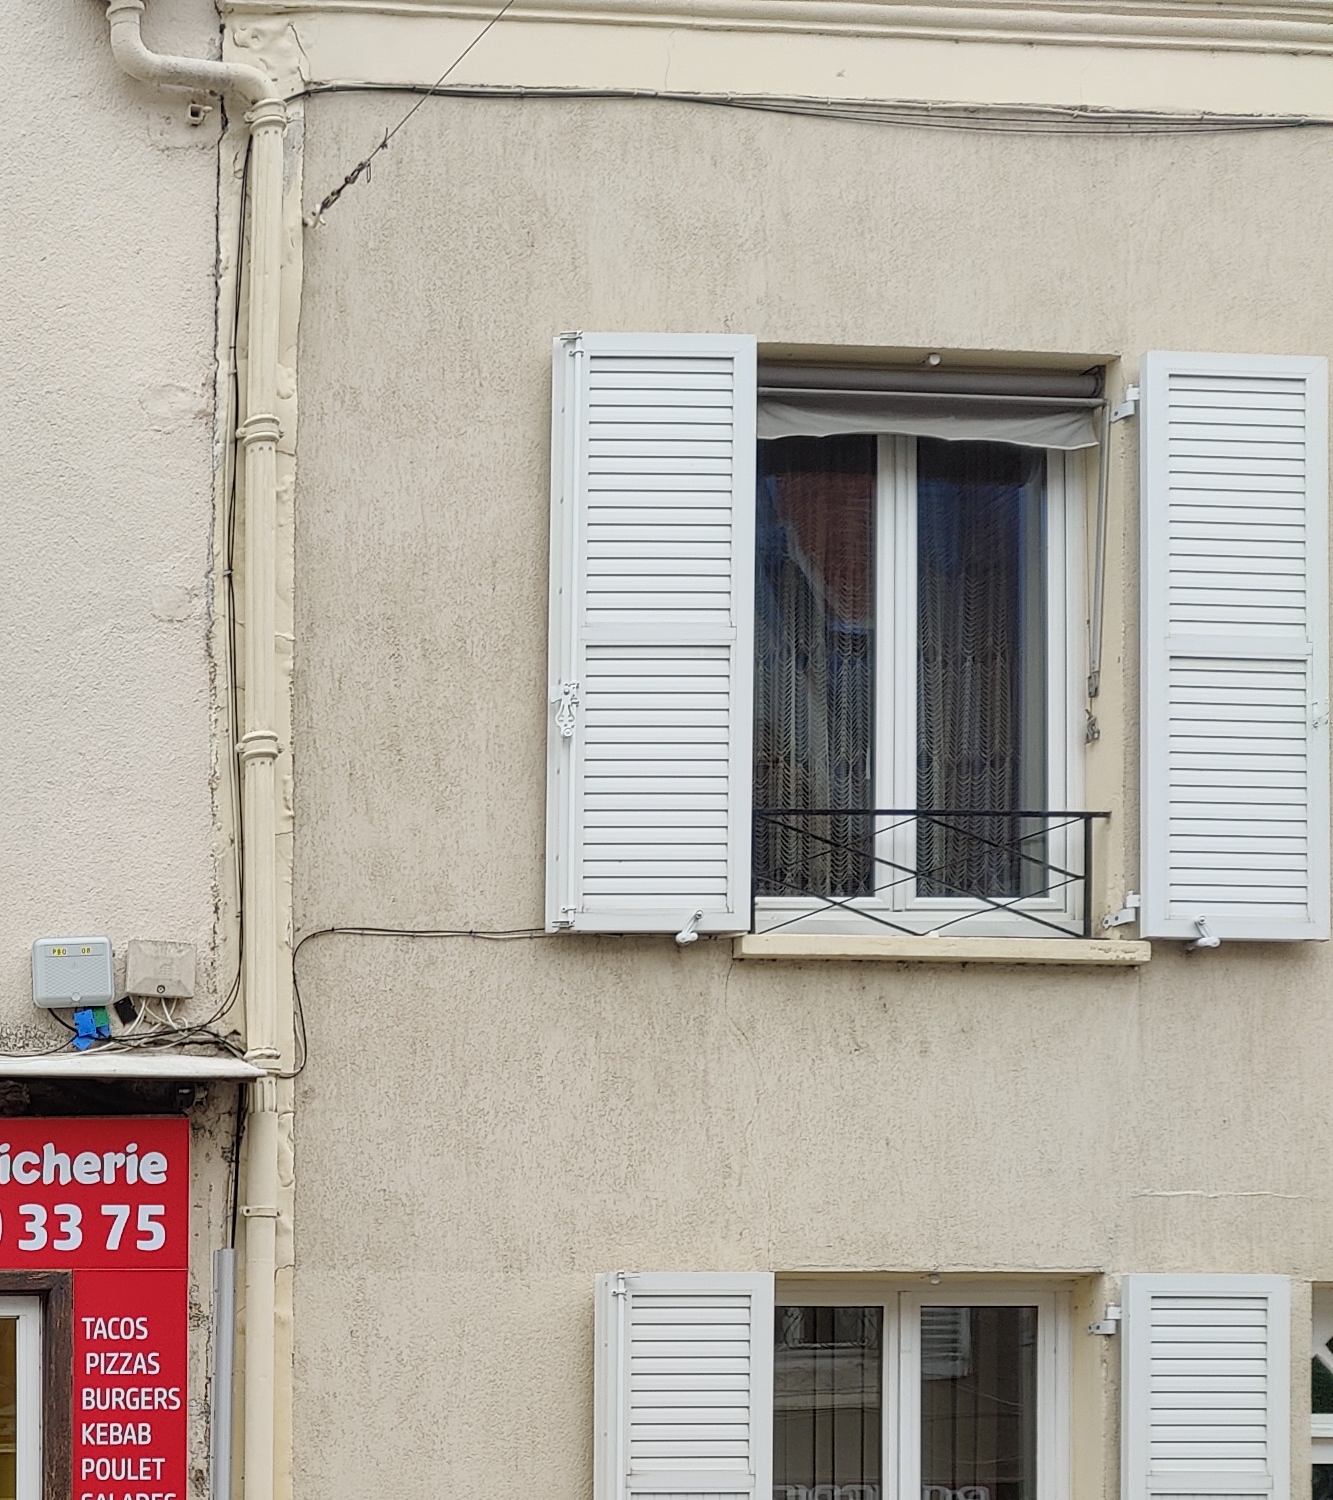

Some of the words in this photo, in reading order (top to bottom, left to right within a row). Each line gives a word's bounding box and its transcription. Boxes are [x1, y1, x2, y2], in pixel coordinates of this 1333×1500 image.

[18, 1203, 83, 1252] 33
[100, 1203, 167, 1252] 75
[82, 1317, 149, 1340] TACOS
[85, 1352, 160, 1375] PIZZAS
[82, 1387, 181, 1411] BURGERS
[82, 1422, 152, 1446] KEBAB
[82, 1458, 165, 1481] POULET
